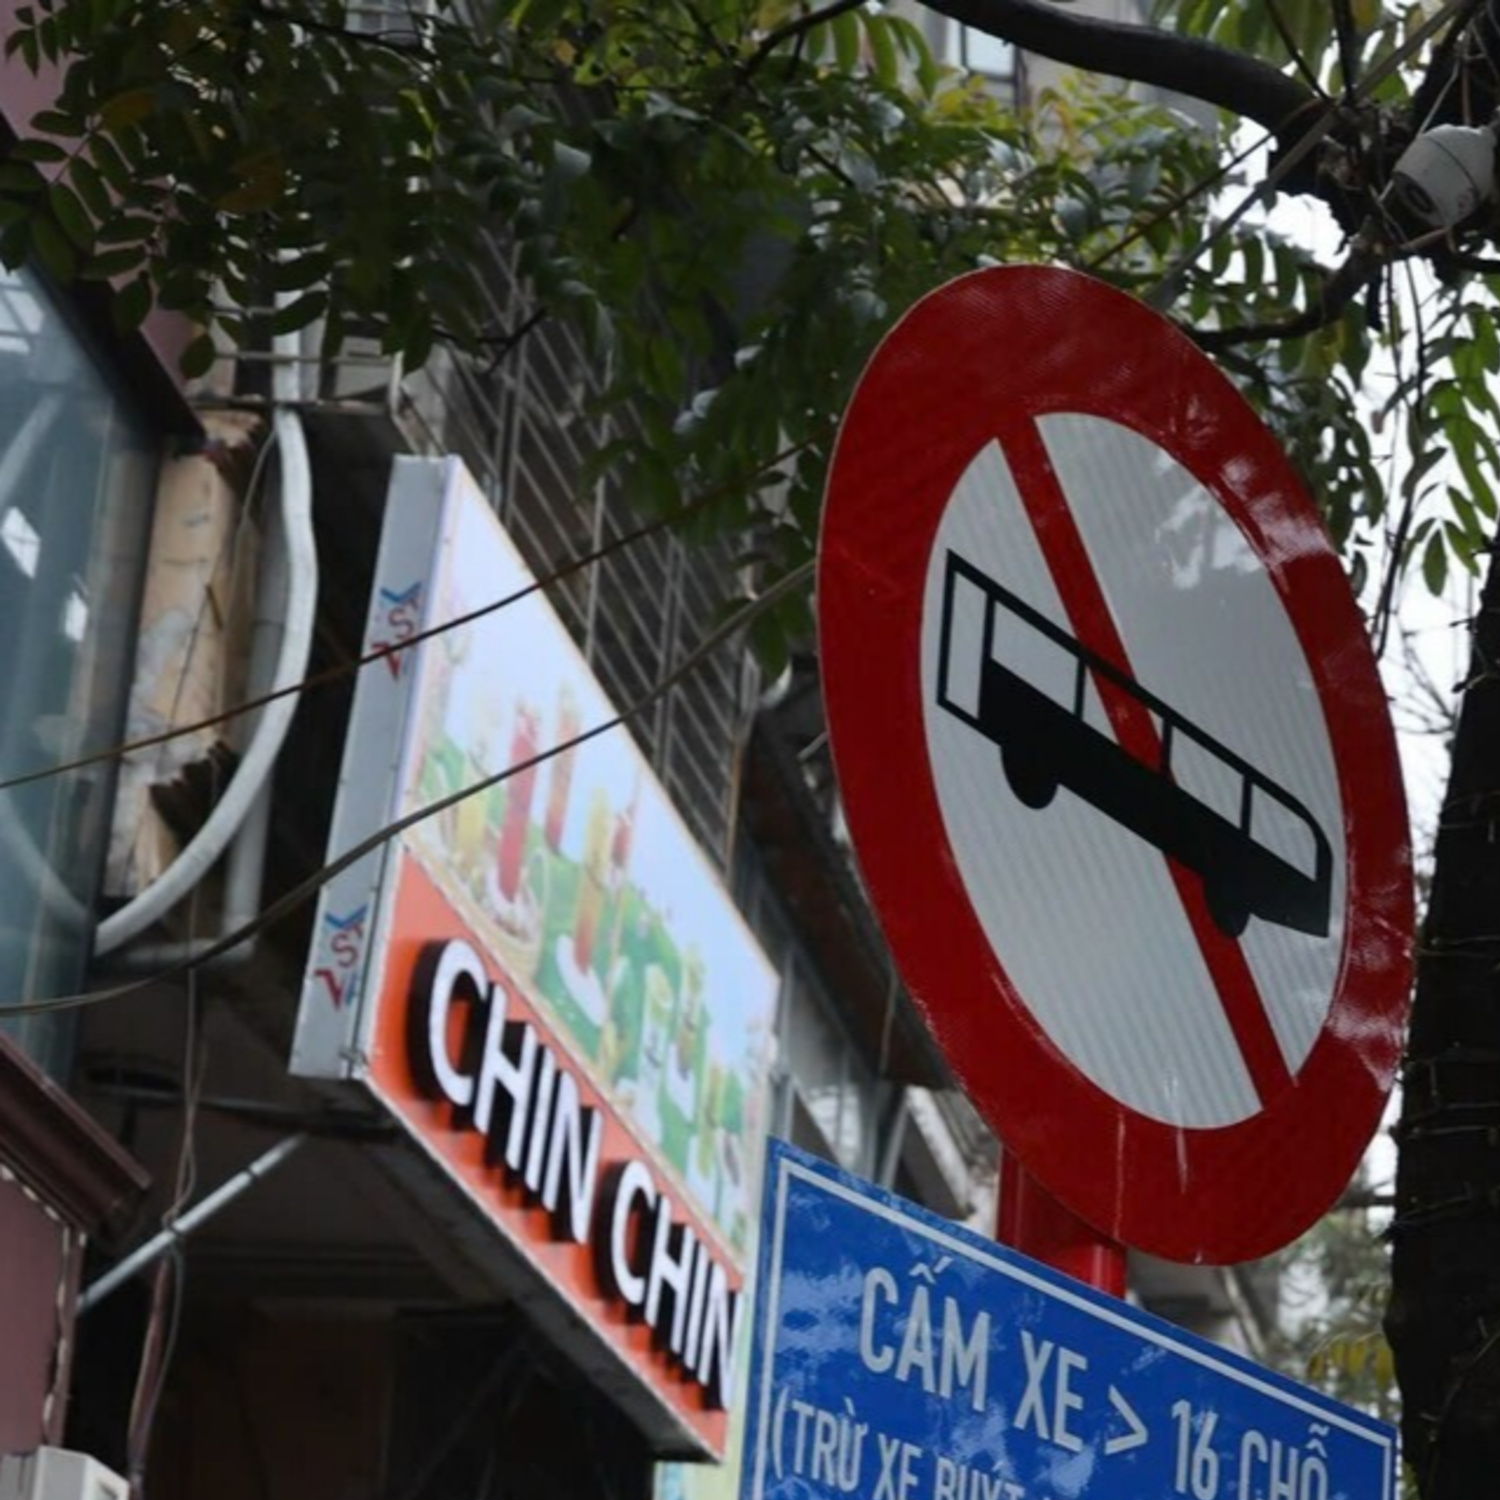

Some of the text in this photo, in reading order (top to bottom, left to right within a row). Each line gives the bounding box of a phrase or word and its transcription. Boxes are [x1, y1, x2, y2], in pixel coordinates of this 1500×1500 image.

[428, 939, 743, 1411] CHIN CHIN
[772, 1386, 868, 1492] (TRỪ
[859, 1256, 990, 1412] CẤM
[1013, 1330, 1088, 1452] XE
